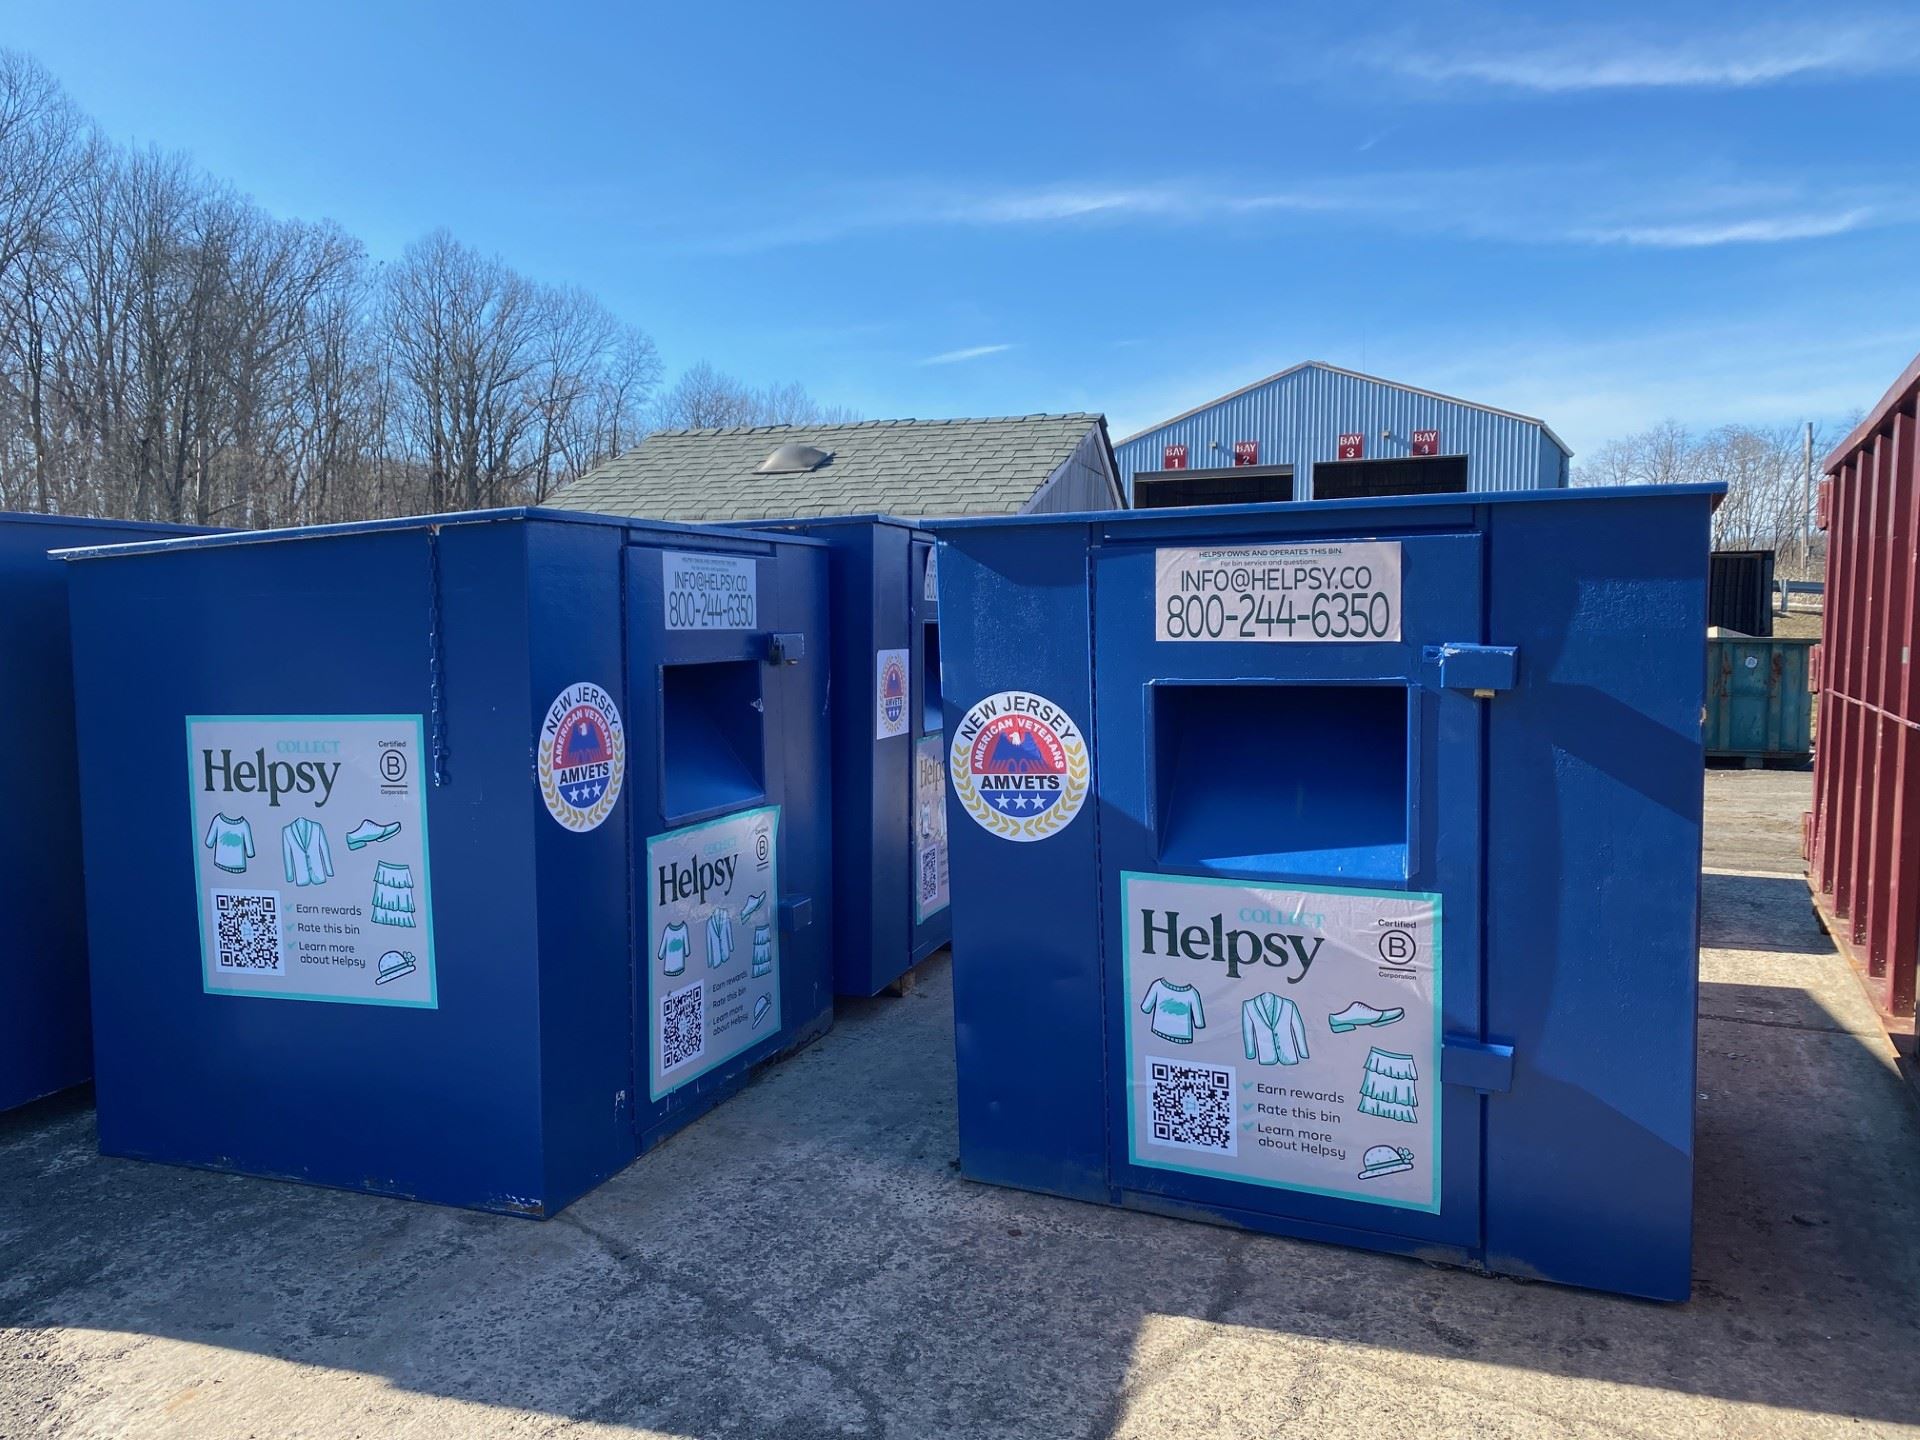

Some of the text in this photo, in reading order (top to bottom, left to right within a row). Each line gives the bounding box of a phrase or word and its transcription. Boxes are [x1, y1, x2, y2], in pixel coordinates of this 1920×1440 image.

[1340, 435, 1361, 445] BAY
[1414, 432, 1436, 442] BAY
[1166, 447, 1185, 456] BAY
[1236, 443, 1256, 453] BAY
[1346, 447, 1355, 457] 3
[1172, 459, 1179, 468] 1
[1243, 455, 1250, 465] 2
[1269, 548, 1309, 556] OPERATES
[1310, 547, 1327, 555] THIS
[674, 571, 747, 591] INFO@HELPSY.CO
[1181, 566, 1372, 593] INFO@HELPSY.CO
[669, 591, 753, 627] 800-244-6350
[1166, 592, 1390, 638] 800-244-6350
[546, 687, 619, 735] NEW JERSEY
[961, 696, 1075, 741] NEW JERSEY
[378, 740, 407, 748] Certified
[555, 709, 612, 764] AMERICAN VETERANS
[974, 718, 1064, 770] AMERICAN VETERANS
[276, 740, 342, 754] COLLECT
[387, 756, 400, 775] B
[559, 762, 609, 785] AMVETS
[920, 755, 945, 792] Helps
[202, 747, 341, 807] Helpsy
[981, 775, 1060, 789] AMVETS
[658, 853, 738, 906] Helpsy
[296, 903, 362, 916] Earn rewards
[1240, 907, 1326, 928] COLLECT
[297, 923, 360, 935] Rate this bin
[1378, 919, 1416, 929] Certified
[298, 941, 355, 953] Learn more
[1141, 908, 1325, 984] Helpsy
[1389, 937, 1406, 958] B
[300, 953, 366, 968] about Helpsy
[1379, 971, 1416, 980] Corporation
[1257, 1083, 1345, 1104] Earn rewards
[1257, 1103, 1341, 1124] Rate this bin
[1257, 1123, 1332, 1143] Learn more
[1258, 1136, 1347, 1161] about Helpsy
